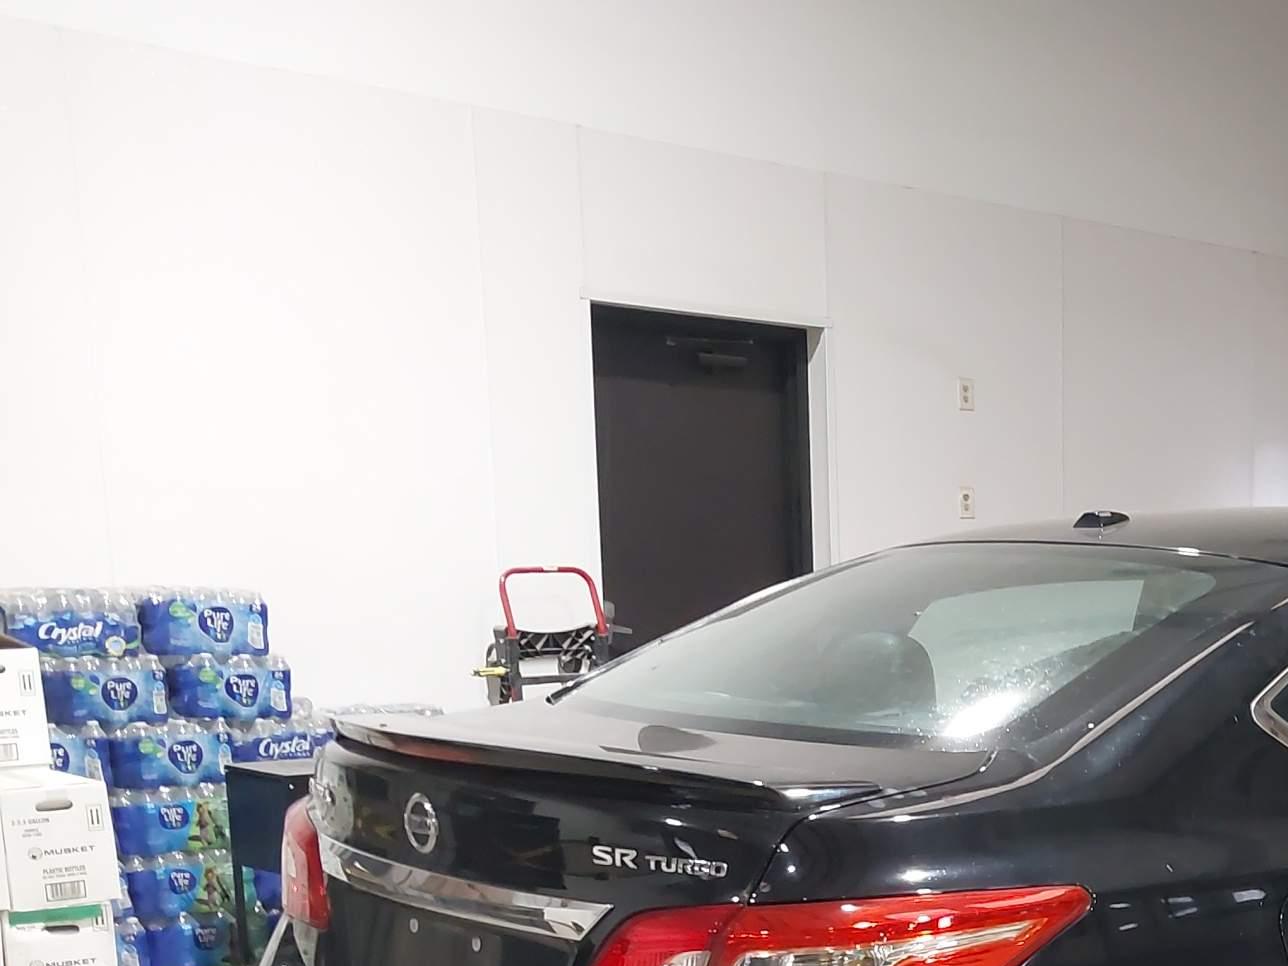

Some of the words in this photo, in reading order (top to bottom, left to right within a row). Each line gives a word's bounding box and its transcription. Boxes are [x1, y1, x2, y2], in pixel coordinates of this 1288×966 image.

[203, 609, 230, 620] Pure
[206, 617, 228, 632] Life
[38, 621, 103, 645] Crystal
[107, 681, 132, 690] Pure
[229, 676, 255, 688] Pure
[110, 689, 130, 703] Life
[173, 744, 197, 753] Pure
[258, 733, 310, 759] Crystal
[177, 753, 196, 765] Life
[161, 807, 184, 815] Pure
[44, 845, 95, 856] MUSKET
[592, 845, 638, 869] SR
[645, 855, 728, 878] TURBO
[170, 871, 191, 879] Pure
